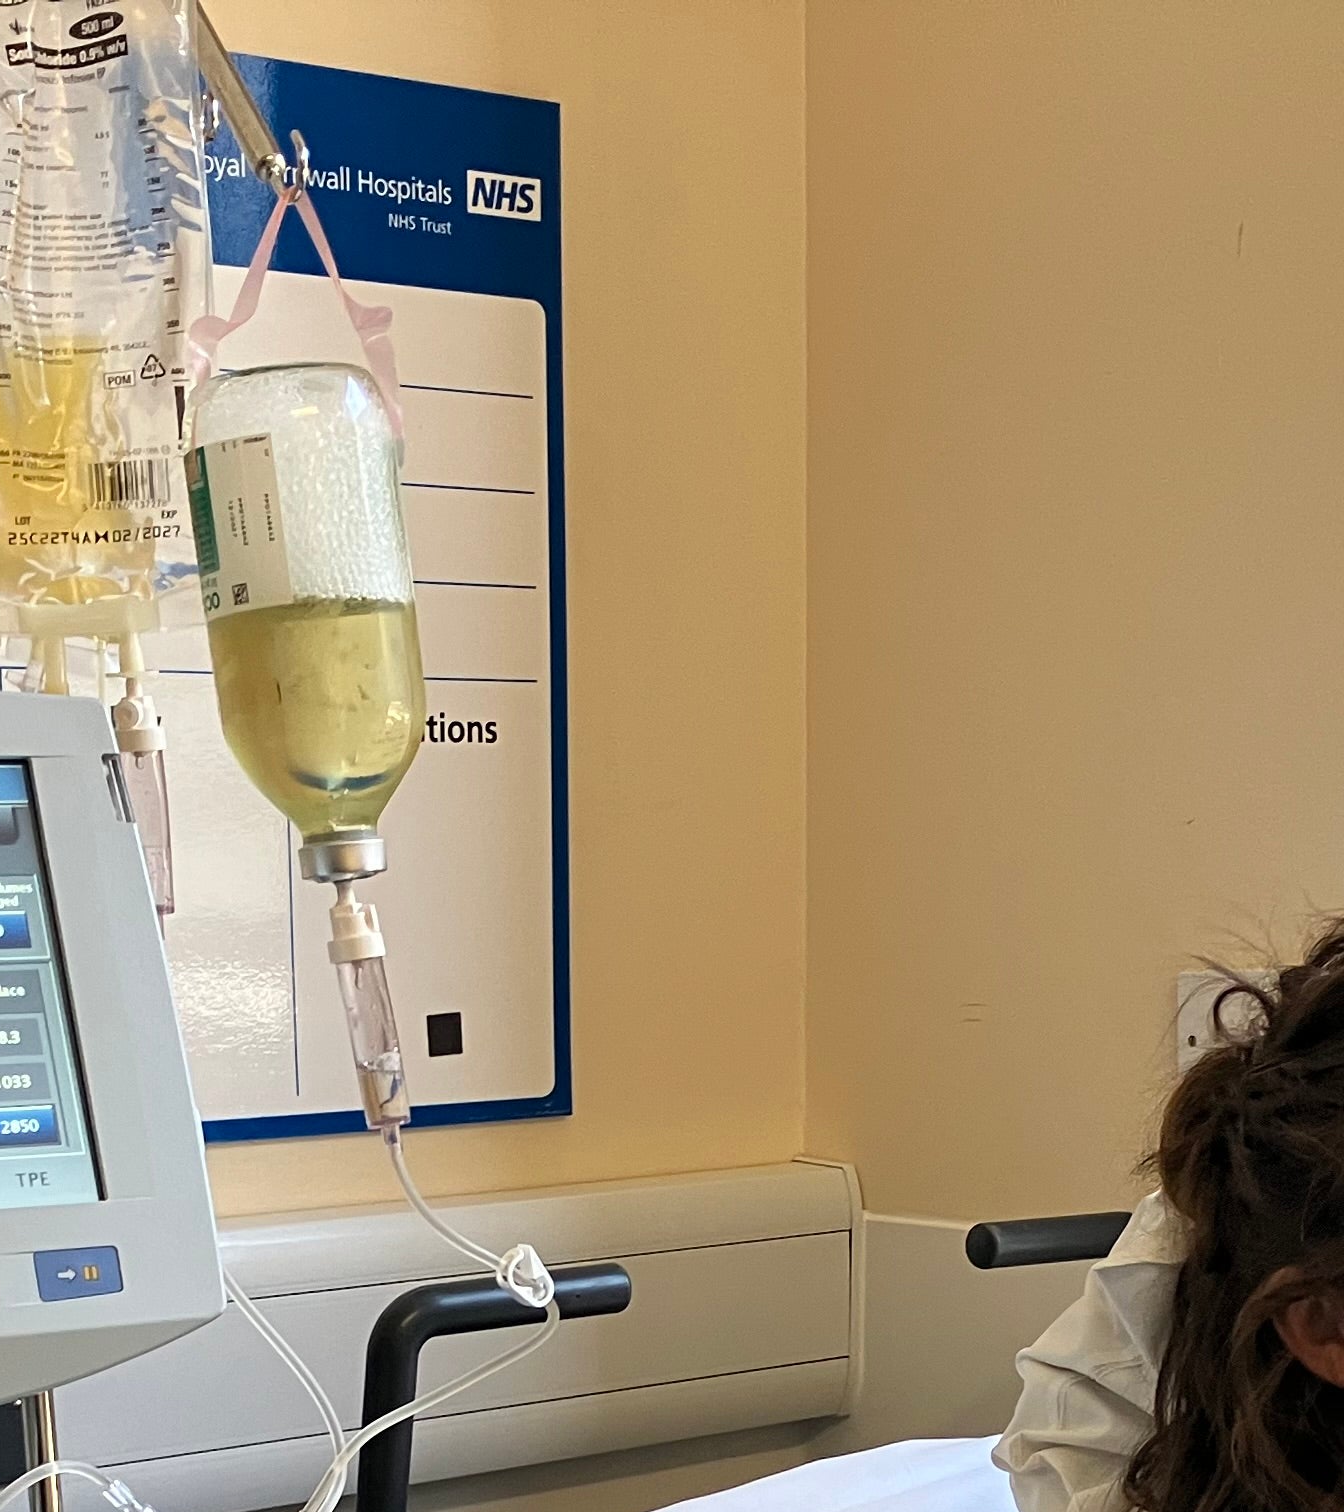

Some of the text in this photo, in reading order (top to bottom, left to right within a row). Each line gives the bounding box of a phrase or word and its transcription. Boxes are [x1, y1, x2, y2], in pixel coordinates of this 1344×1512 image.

[203, 153, 246, 181] oyal
[357, 169, 453, 205] Hospitals
[470, 176, 536, 214] NHS
[388, 213, 452, 235] NHS Trust
[107, 374, 132, 387] POM
[14, 516, 32, 526] LOT
[161, 509, 178, 520] EXP
[421, 712, 498, 743] tions
[0, 1119, 40, 1135] 2850
[15, 1172, 51, 1188] TPE
